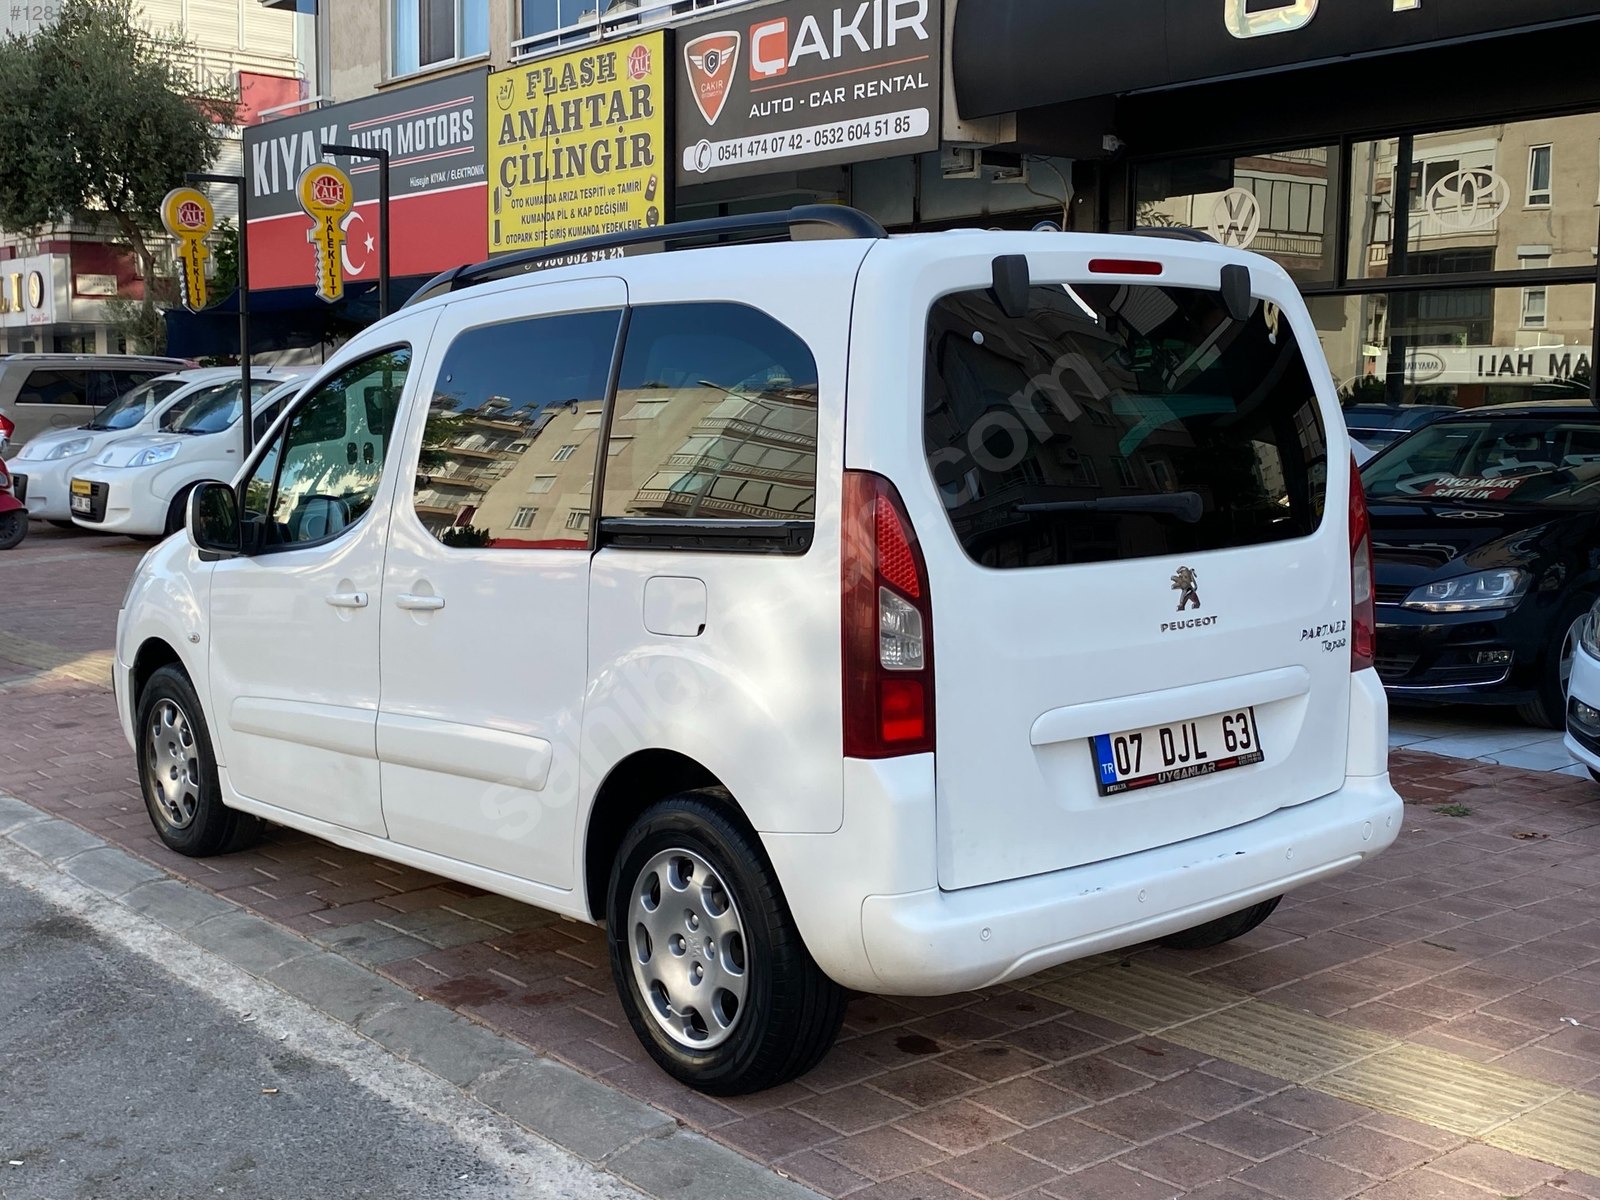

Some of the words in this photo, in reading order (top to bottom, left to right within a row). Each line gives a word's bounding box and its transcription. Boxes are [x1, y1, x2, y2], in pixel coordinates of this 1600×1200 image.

[751, 0, 929, 76] ÇAKIR
[525, 51, 617, 99] FLASH
[628, 55, 651, 77] KALE
[749, 97, 794, 118] AUTO
[809, 88, 846, 108] CAR
[854, 72, 929, 100] RENTAL
[498, 83, 654, 146] ANAHTAR
[350, 127, 392, 165] AUTO
[397, 108, 474, 155] MOTORS
[718, 142, 744, 161] 0541
[747, 139, 768, 157] 474
[771, 136, 785, 153] 07
[788, 133, 803, 150] 42
[814, 126, 844, 145] 0532
[847, 122, 870, 140] 604
[875, 118, 889, 137] 51
[894, 115, 910, 133] 85
[500, 125, 655, 197] ÇİLİNGİR
[430, 171, 446, 184] KIYAK
[311, 181, 345, 204] KALE
[511, 198, 524, 209] OTO
[525, 193, 557, 207] KUMANDA
[559, 190, 578, 202] ARIZA
[608, 187, 616, 196] ve
[177, 206, 207, 226] KALE
[521, 211, 555, 225] KUMANDA
[570, 209, 575, 219] &
[577, 206, 592, 218] KAP
[506, 232, 533, 245] OTOPARK
[568, 224, 600, 237] KUMANDA
[601, 219, 642, 233] YEDEKLEME
[1432, 488, 1495, 499] SATILIK
[1434, 477, 1520, 488] UYGANLAR
[1160, 615, 1218, 632] PEUGEOT
[1299, 620, 1346, 641] PARTNER
[1113, 733, 1143, 776] 07
[1158, 721, 1208, 766] DJL
[1222, 712, 1251, 752] 63
[1102, 763, 1115, 775] TR
[1158, 762, 1216, 784] UYGANLAR
